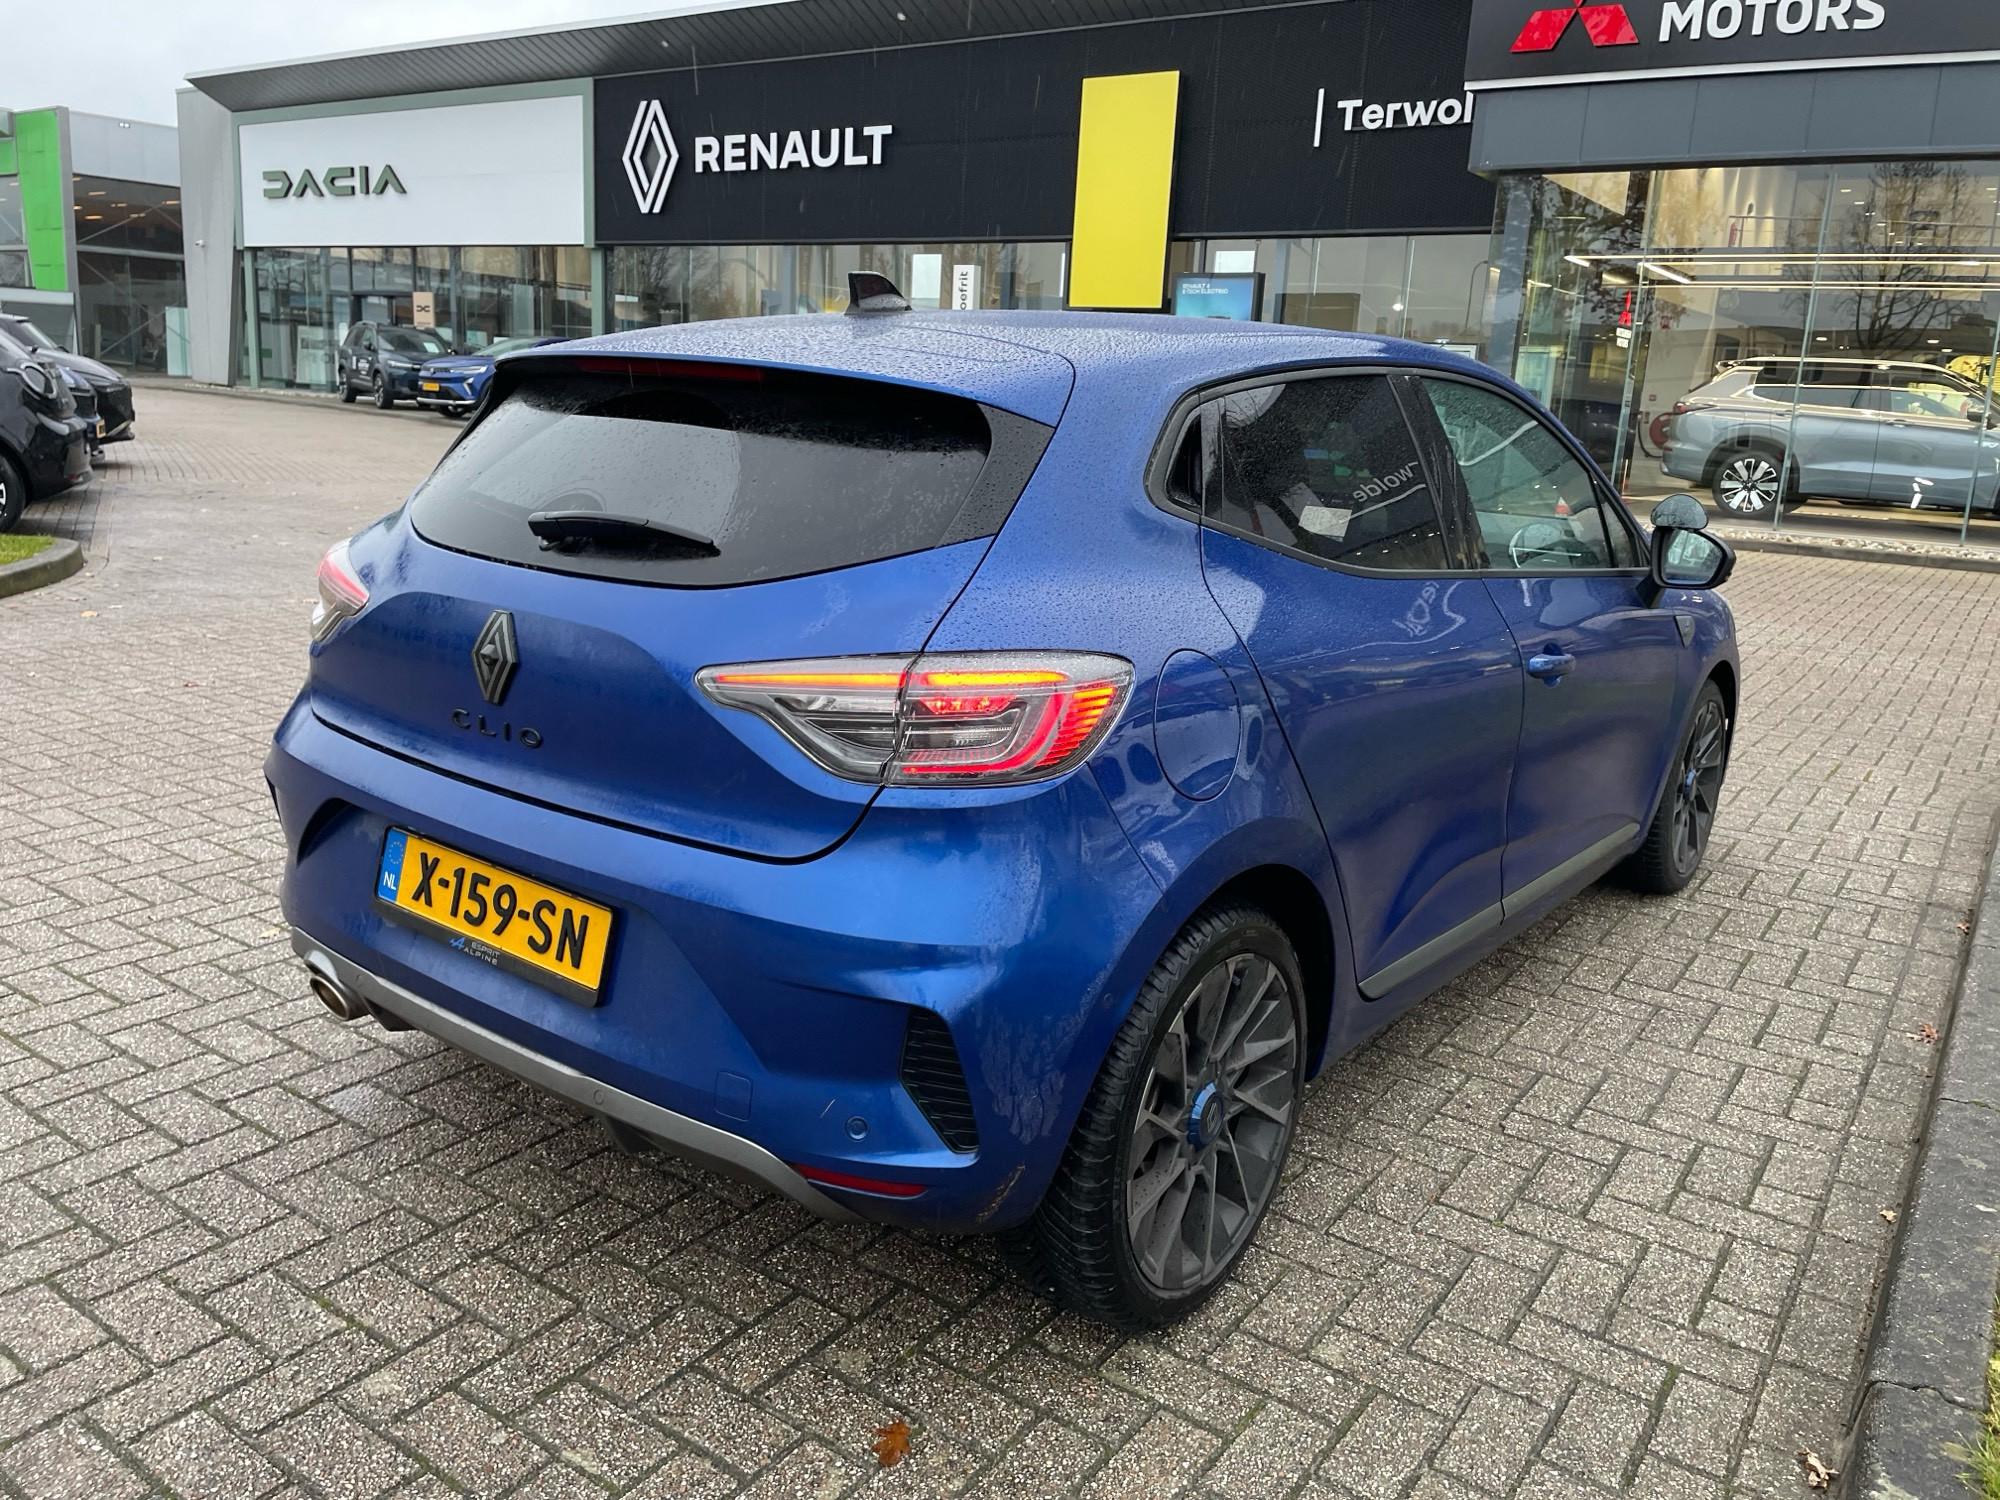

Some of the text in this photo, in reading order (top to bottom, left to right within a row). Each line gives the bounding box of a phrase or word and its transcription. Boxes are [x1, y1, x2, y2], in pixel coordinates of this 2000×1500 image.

[1658, 0, 1886, 42] MOTORS
[1337, 91, 1474, 131] Terwol
[694, 124, 894, 174] RENAULT
[262, 164, 408, 199] DACIA
[452, 707, 543, 748] CLIO
[383, 871, 397, 891] NL
[411, 852, 590, 970] X-159-SN
[463, 947, 498, 966] ALPINE
[471, 941, 501, 958] ESPRIT
